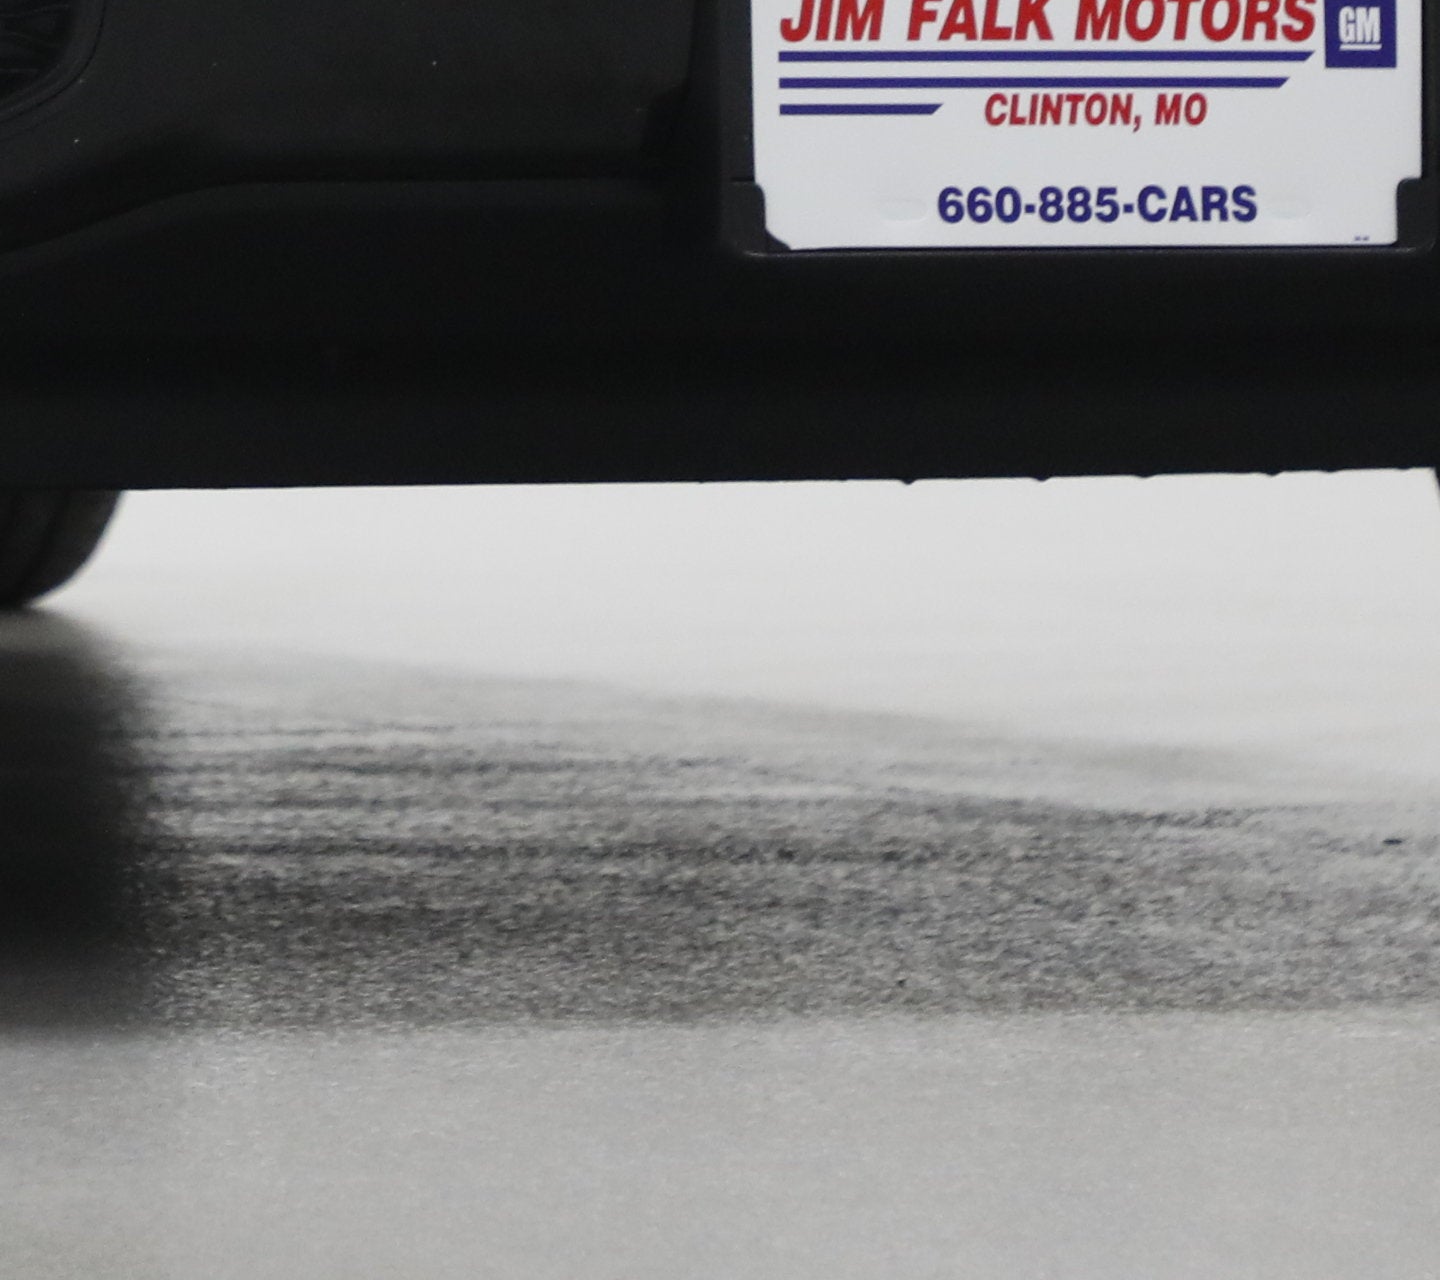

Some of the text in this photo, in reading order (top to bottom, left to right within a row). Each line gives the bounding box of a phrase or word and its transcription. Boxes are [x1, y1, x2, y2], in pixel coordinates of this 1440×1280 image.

[1339, 5, 1381, 43] GM
[985, 93, 1209, 134] CLINTON, MO
[938, 185, 1259, 225] 660-885-CARS
